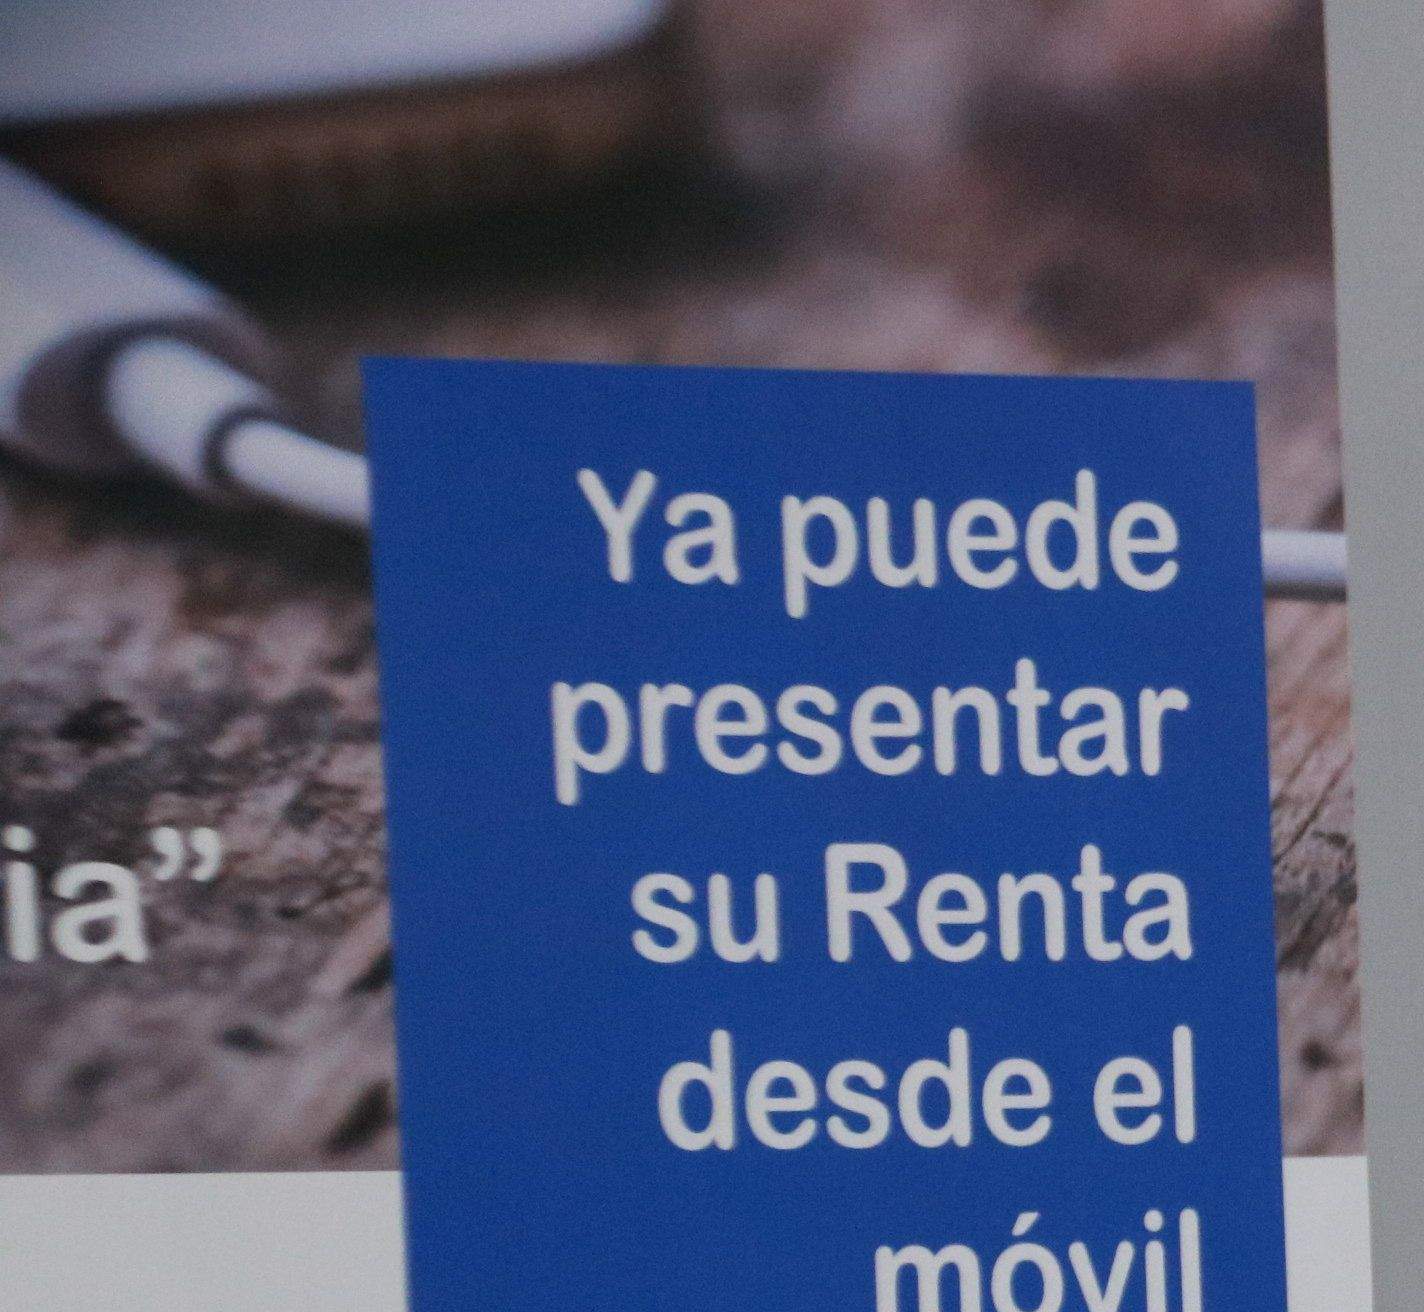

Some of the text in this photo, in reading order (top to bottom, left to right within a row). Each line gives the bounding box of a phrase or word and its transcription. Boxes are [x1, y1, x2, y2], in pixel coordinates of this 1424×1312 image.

[577, 468, 1181, 621] Ya puede
[551, 657, 1192, 809] presentar
[630, 842, 1196, 967] su Renta
[657, 1024, 1199, 1154] desde el
